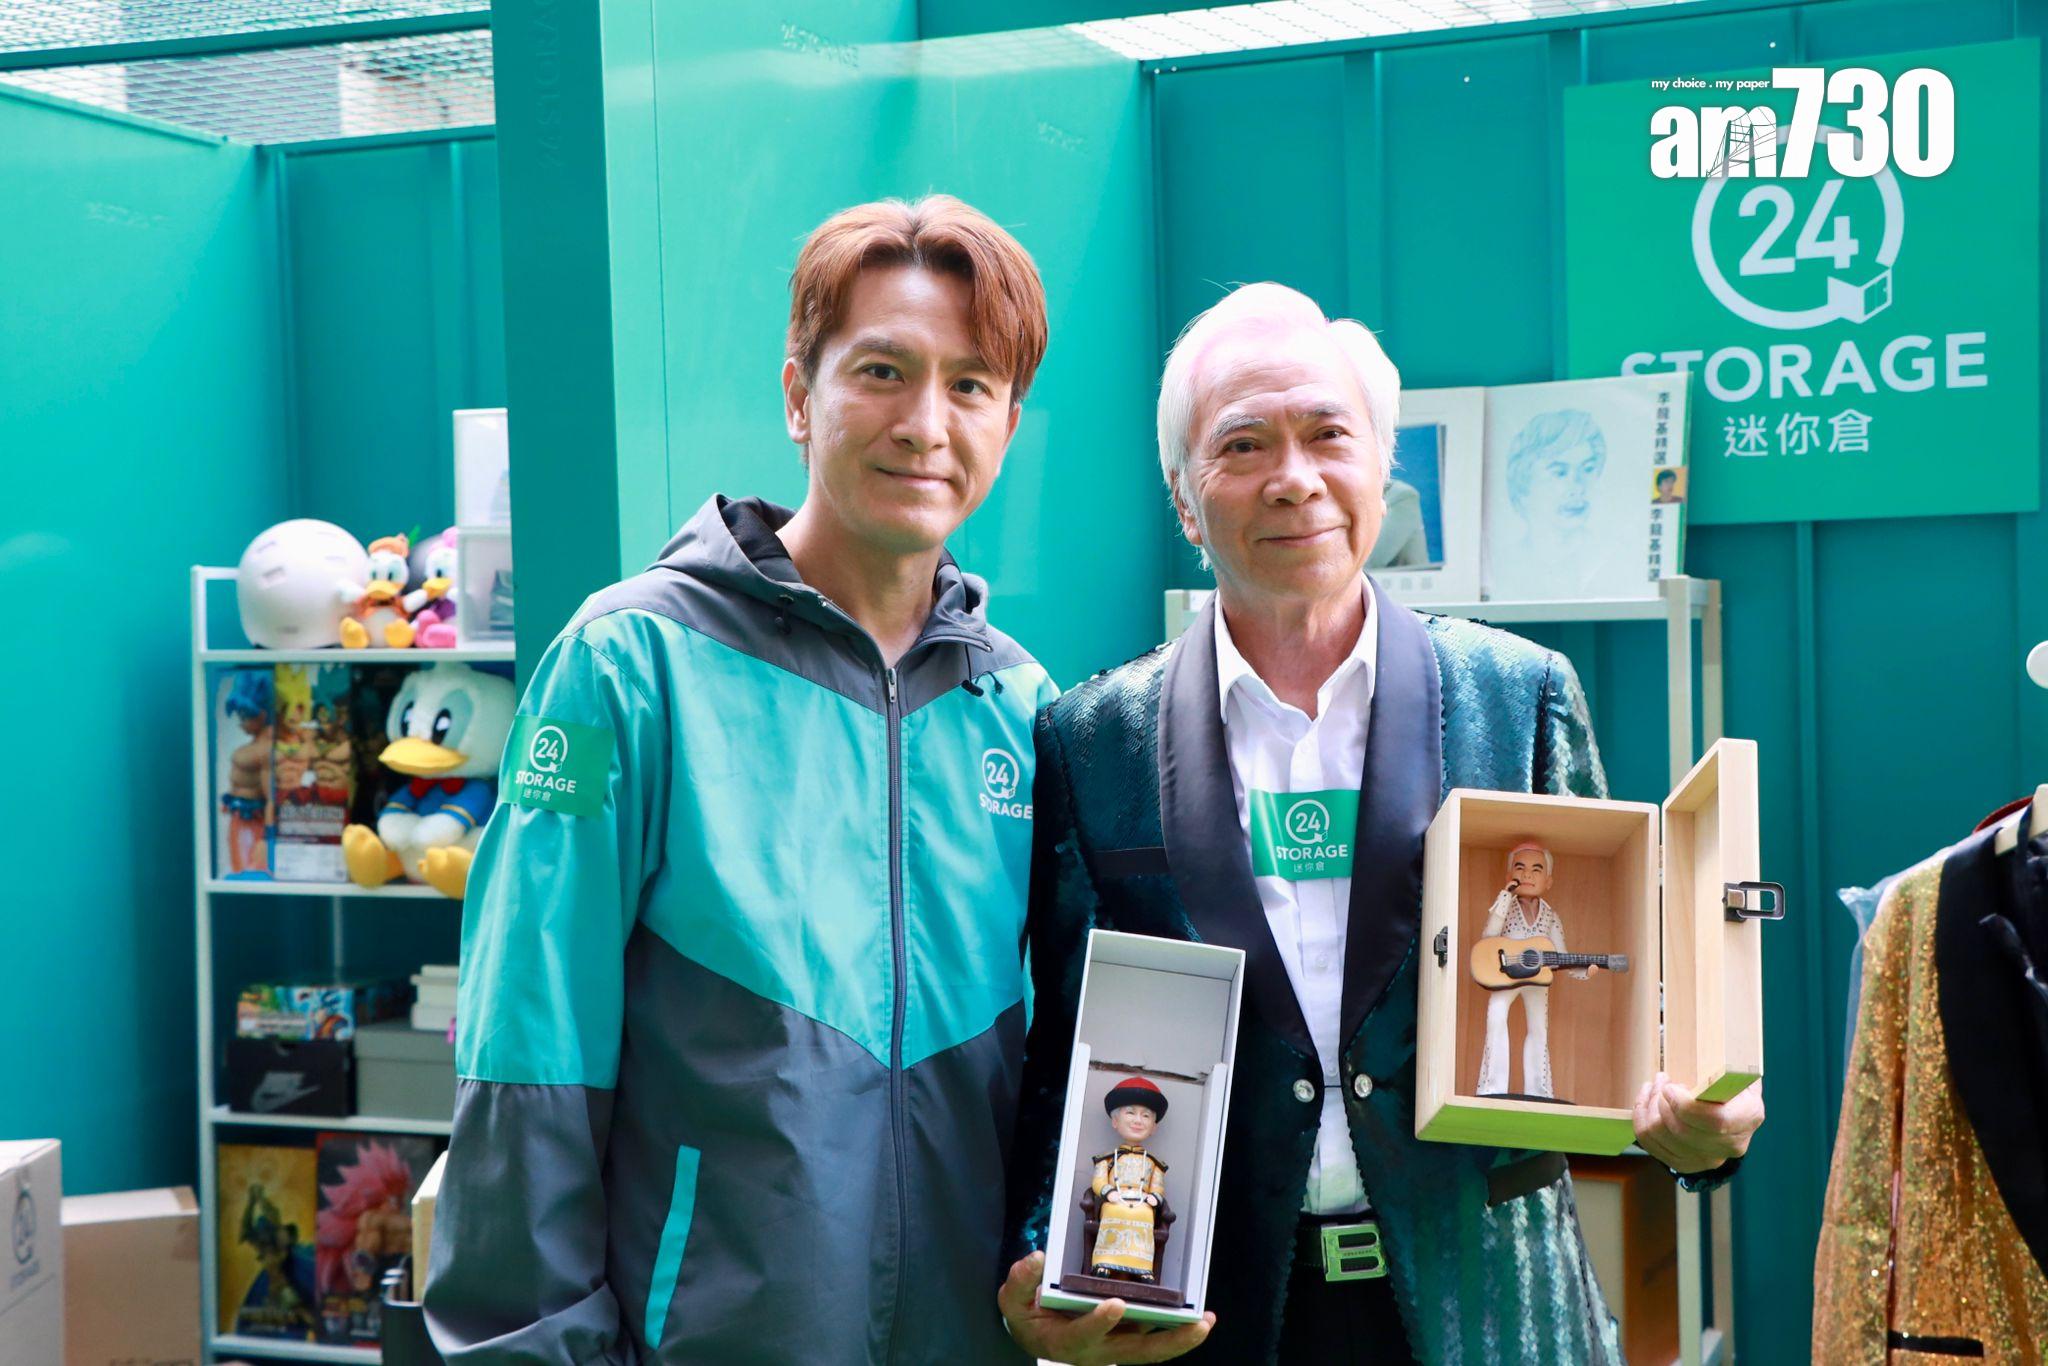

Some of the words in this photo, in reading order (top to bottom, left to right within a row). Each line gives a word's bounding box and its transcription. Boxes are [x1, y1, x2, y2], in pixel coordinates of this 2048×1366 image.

[1738, 179, 1859, 277] 24
[1723, 408, 1873, 458] 迷你倉
[535, 737, 559, 760] 24
[986, 761, 1010, 786] 24
[979, 792, 1033, 820] SORAGE
[1295, 810, 1321, 833] 24
[1293, 860, 1325, 873] 迷你倉
